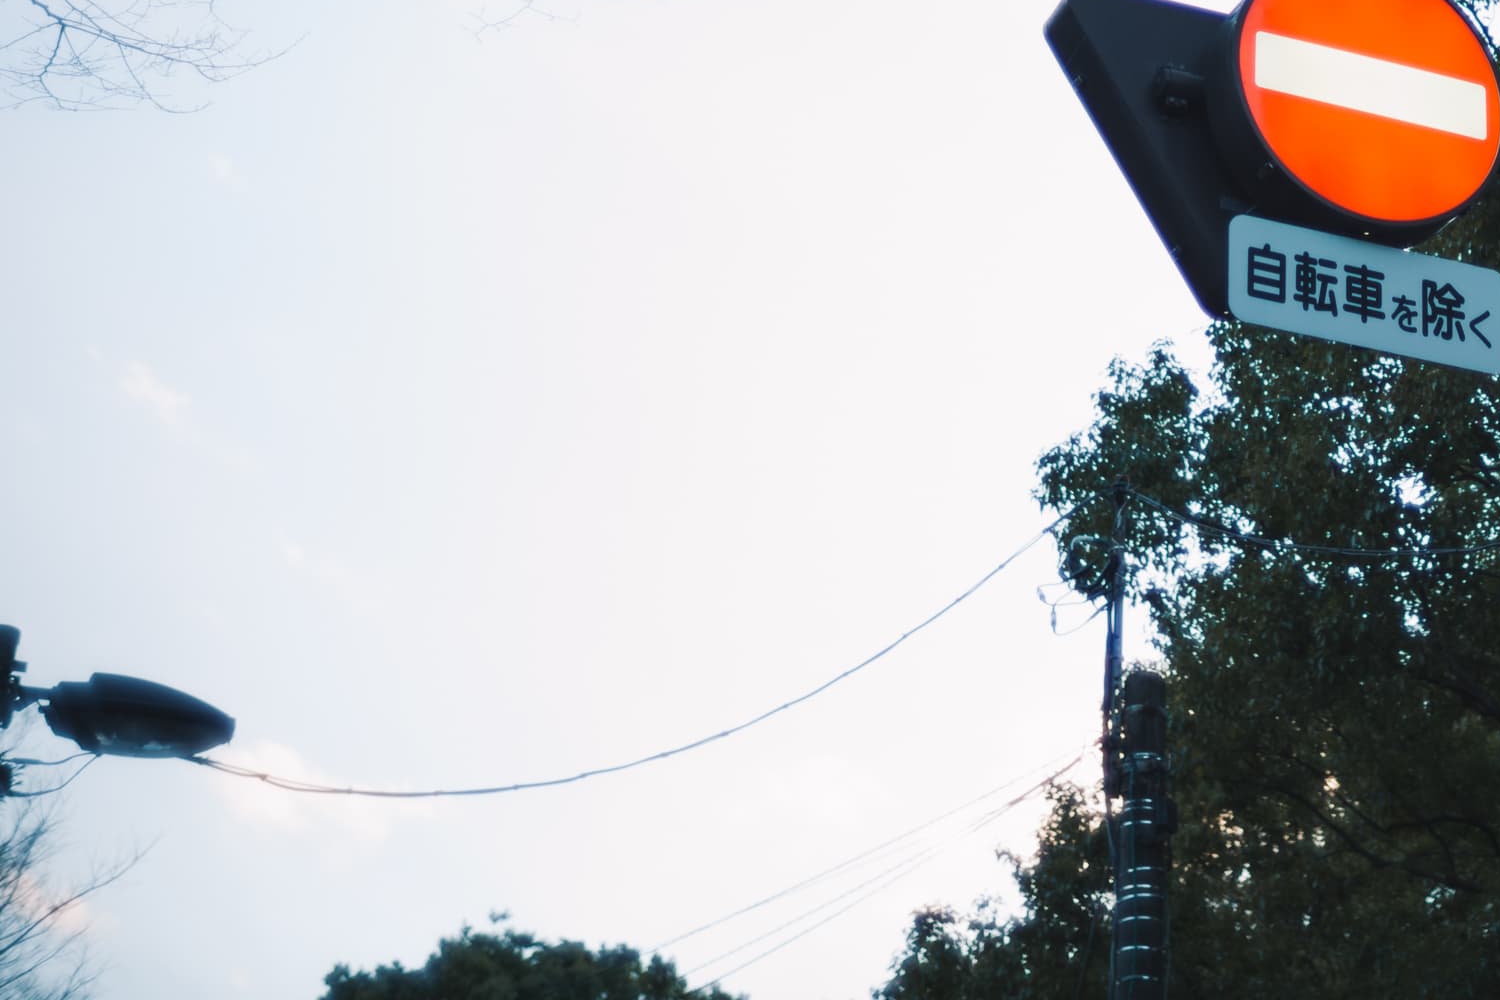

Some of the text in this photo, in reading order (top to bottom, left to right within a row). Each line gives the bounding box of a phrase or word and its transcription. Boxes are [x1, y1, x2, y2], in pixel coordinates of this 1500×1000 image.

[1247, 244, 1492, 349] 自転車を除く
